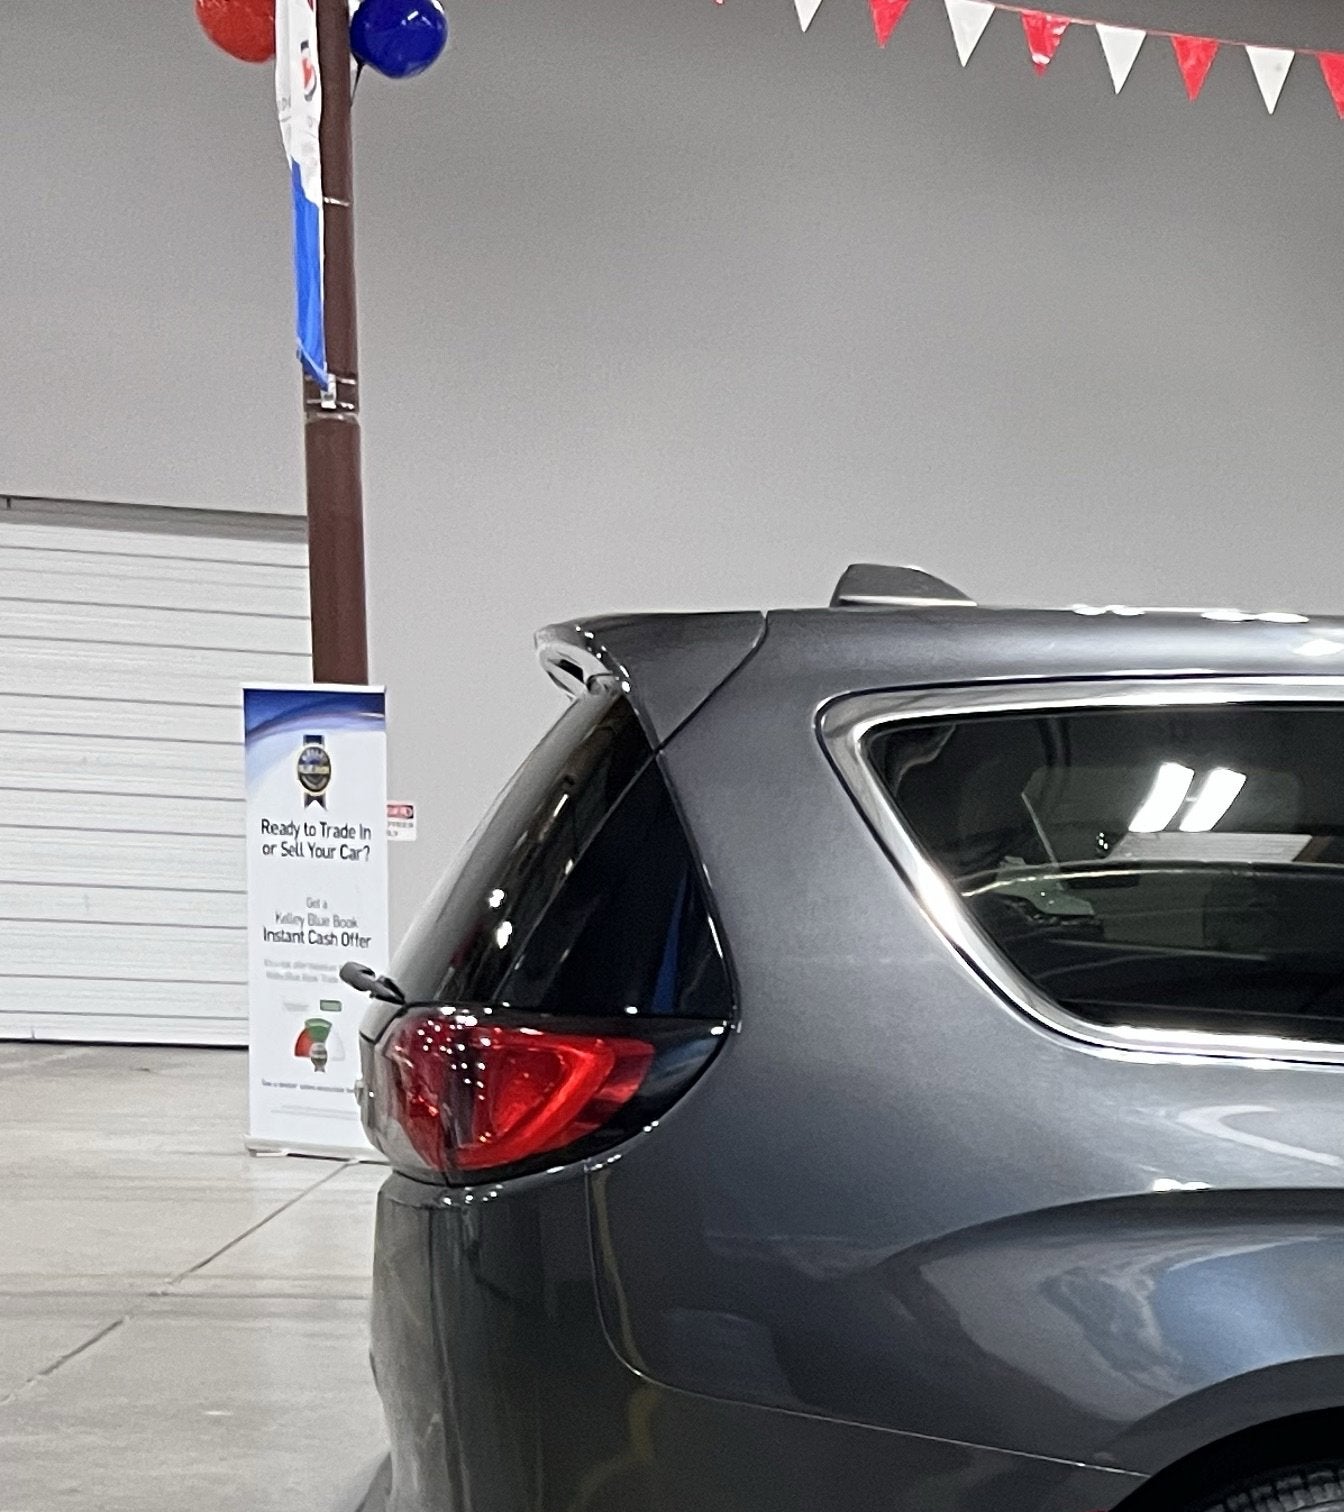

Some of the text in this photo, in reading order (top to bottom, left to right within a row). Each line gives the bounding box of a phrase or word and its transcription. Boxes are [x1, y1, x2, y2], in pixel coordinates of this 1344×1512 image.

[261, 818, 372, 841] Ready to Trade In
[262, 841, 371, 862] or Sell Your Car?
[332, 914, 359, 929] Book
[263, 925, 372, 949] Instant Cash Offer
